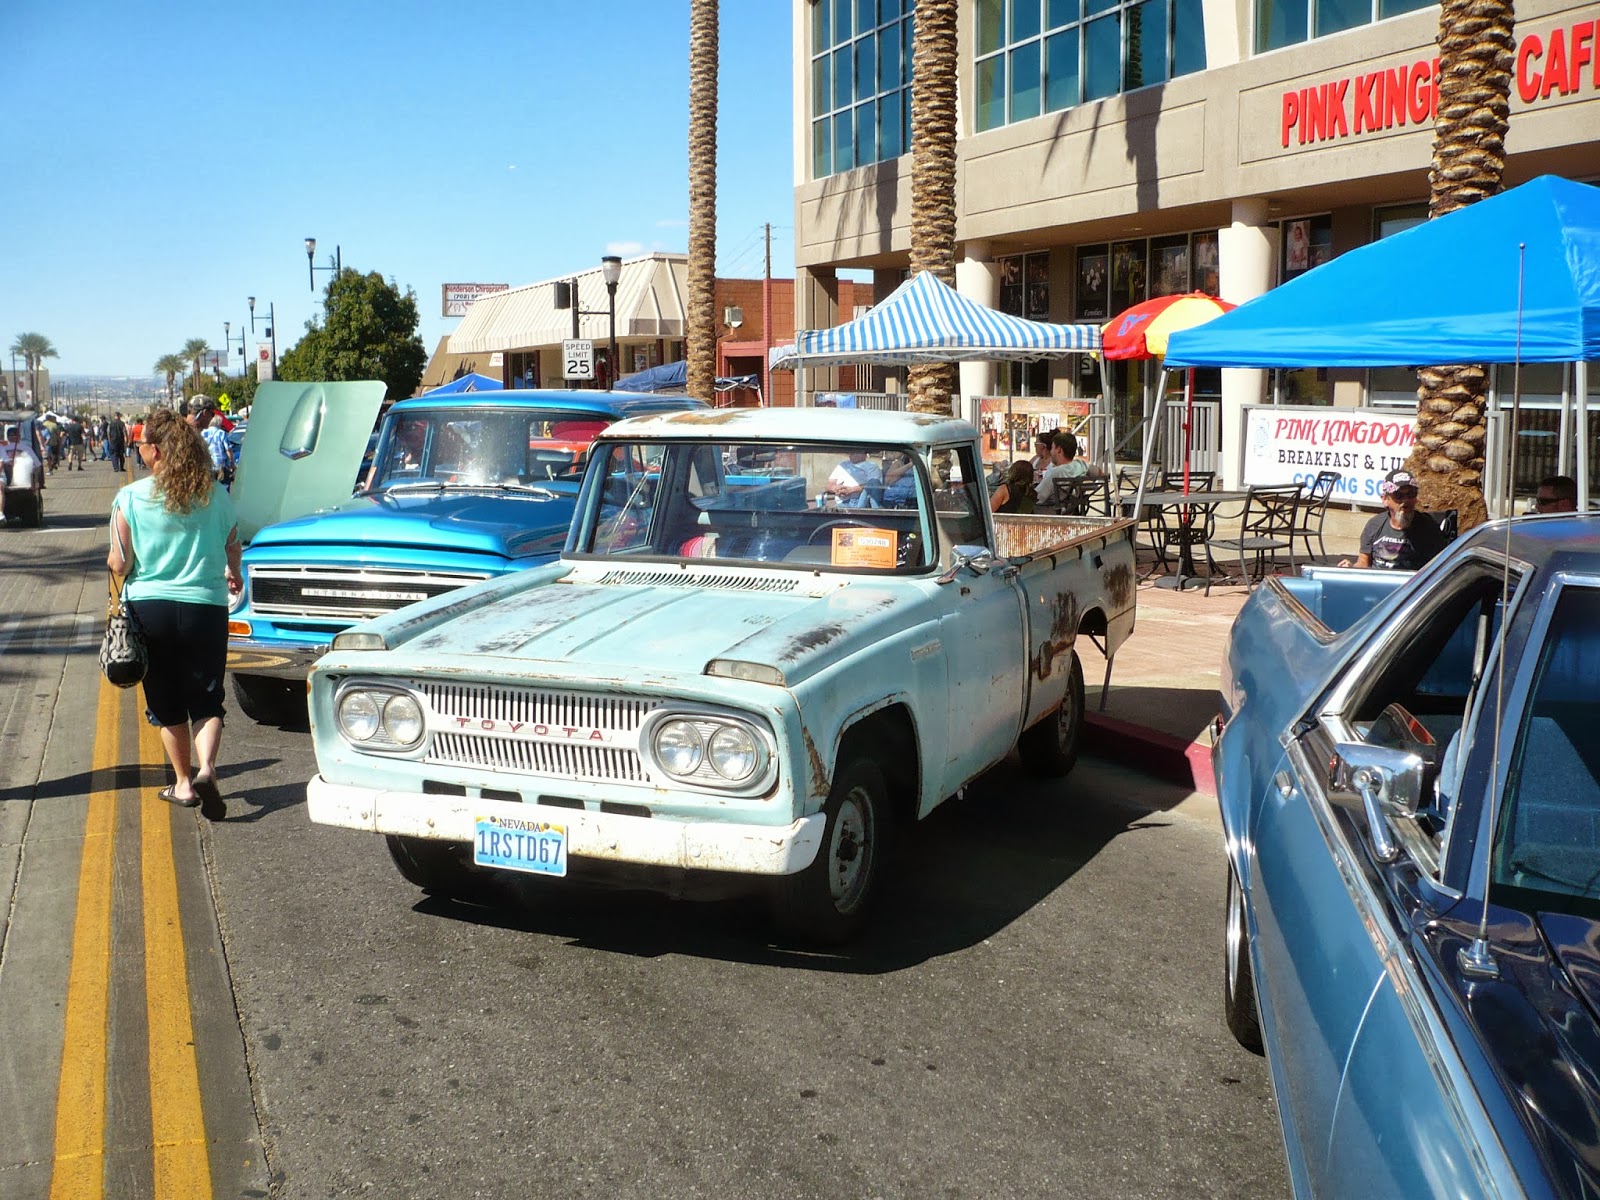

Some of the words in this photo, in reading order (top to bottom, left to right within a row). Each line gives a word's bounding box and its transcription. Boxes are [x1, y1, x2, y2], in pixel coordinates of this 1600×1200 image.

[1281, 78, 1350, 148] PINK
[1354, 57, 1440, 133] KING
[565, 343, 591, 351] SPEED
[568, 351, 588, 359] LIMIT
[567, 360, 590, 374] 25
[1274, 418, 1321, 446] PINK
[1321, 419, 1416, 447] KINGDOM
[1278, 449, 1358, 469] BREAKFAST
[1364, 454, 1375, 470] &
[1380, 455, 1406, 471] LU
[1293, 472, 1357, 495] COMNG
[1364, 478, 1384, 497] SO
[306, 589, 422, 600] INTERNATIONAL
[456, 717, 604, 741] TOYOTA
[499, 818, 541, 832] NEVADA
[478, 830, 562, 865] 1RSTD67
